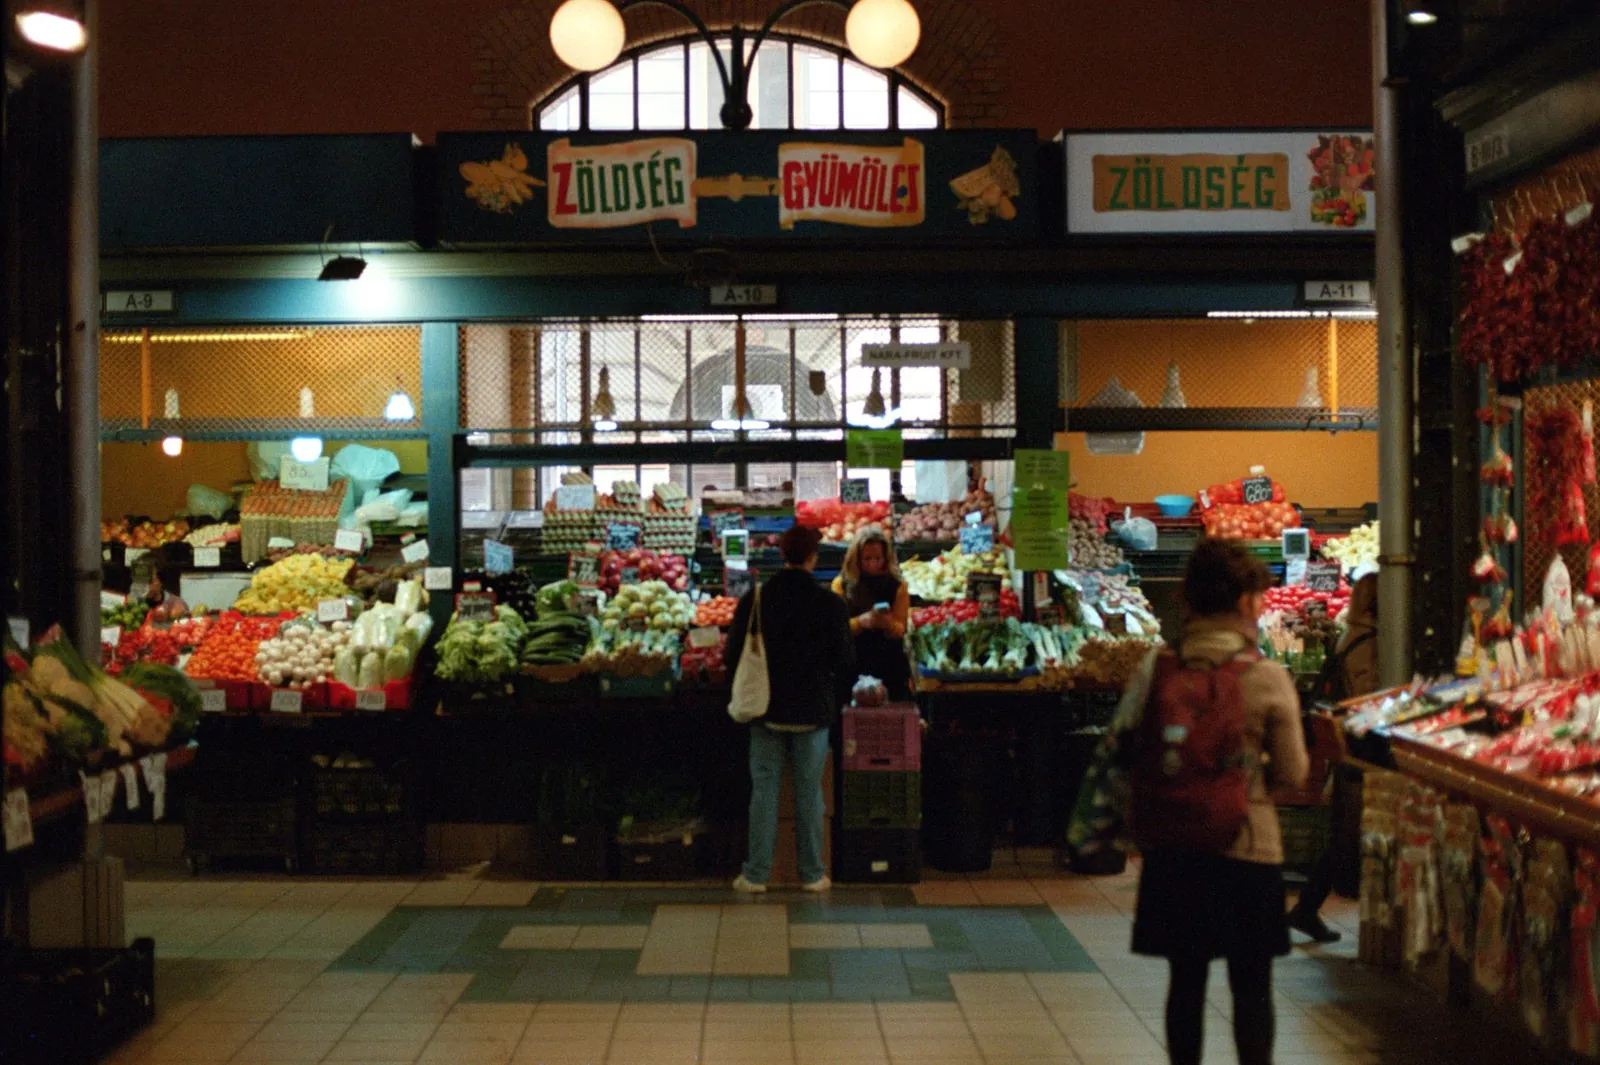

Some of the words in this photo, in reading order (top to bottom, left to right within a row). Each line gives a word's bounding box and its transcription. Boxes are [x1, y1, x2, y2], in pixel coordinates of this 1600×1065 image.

[552, 150, 684, 215] ZÖLDSÉG
[783, 153, 920, 214] GYÜMÖLCS
[1107, 155, 1276, 209] ZÖLDSÉG
[125, 293, 153, 309] A-9
[723, 286, 763, 302] A-10
[1319, 283, 1355, 298] A-11
